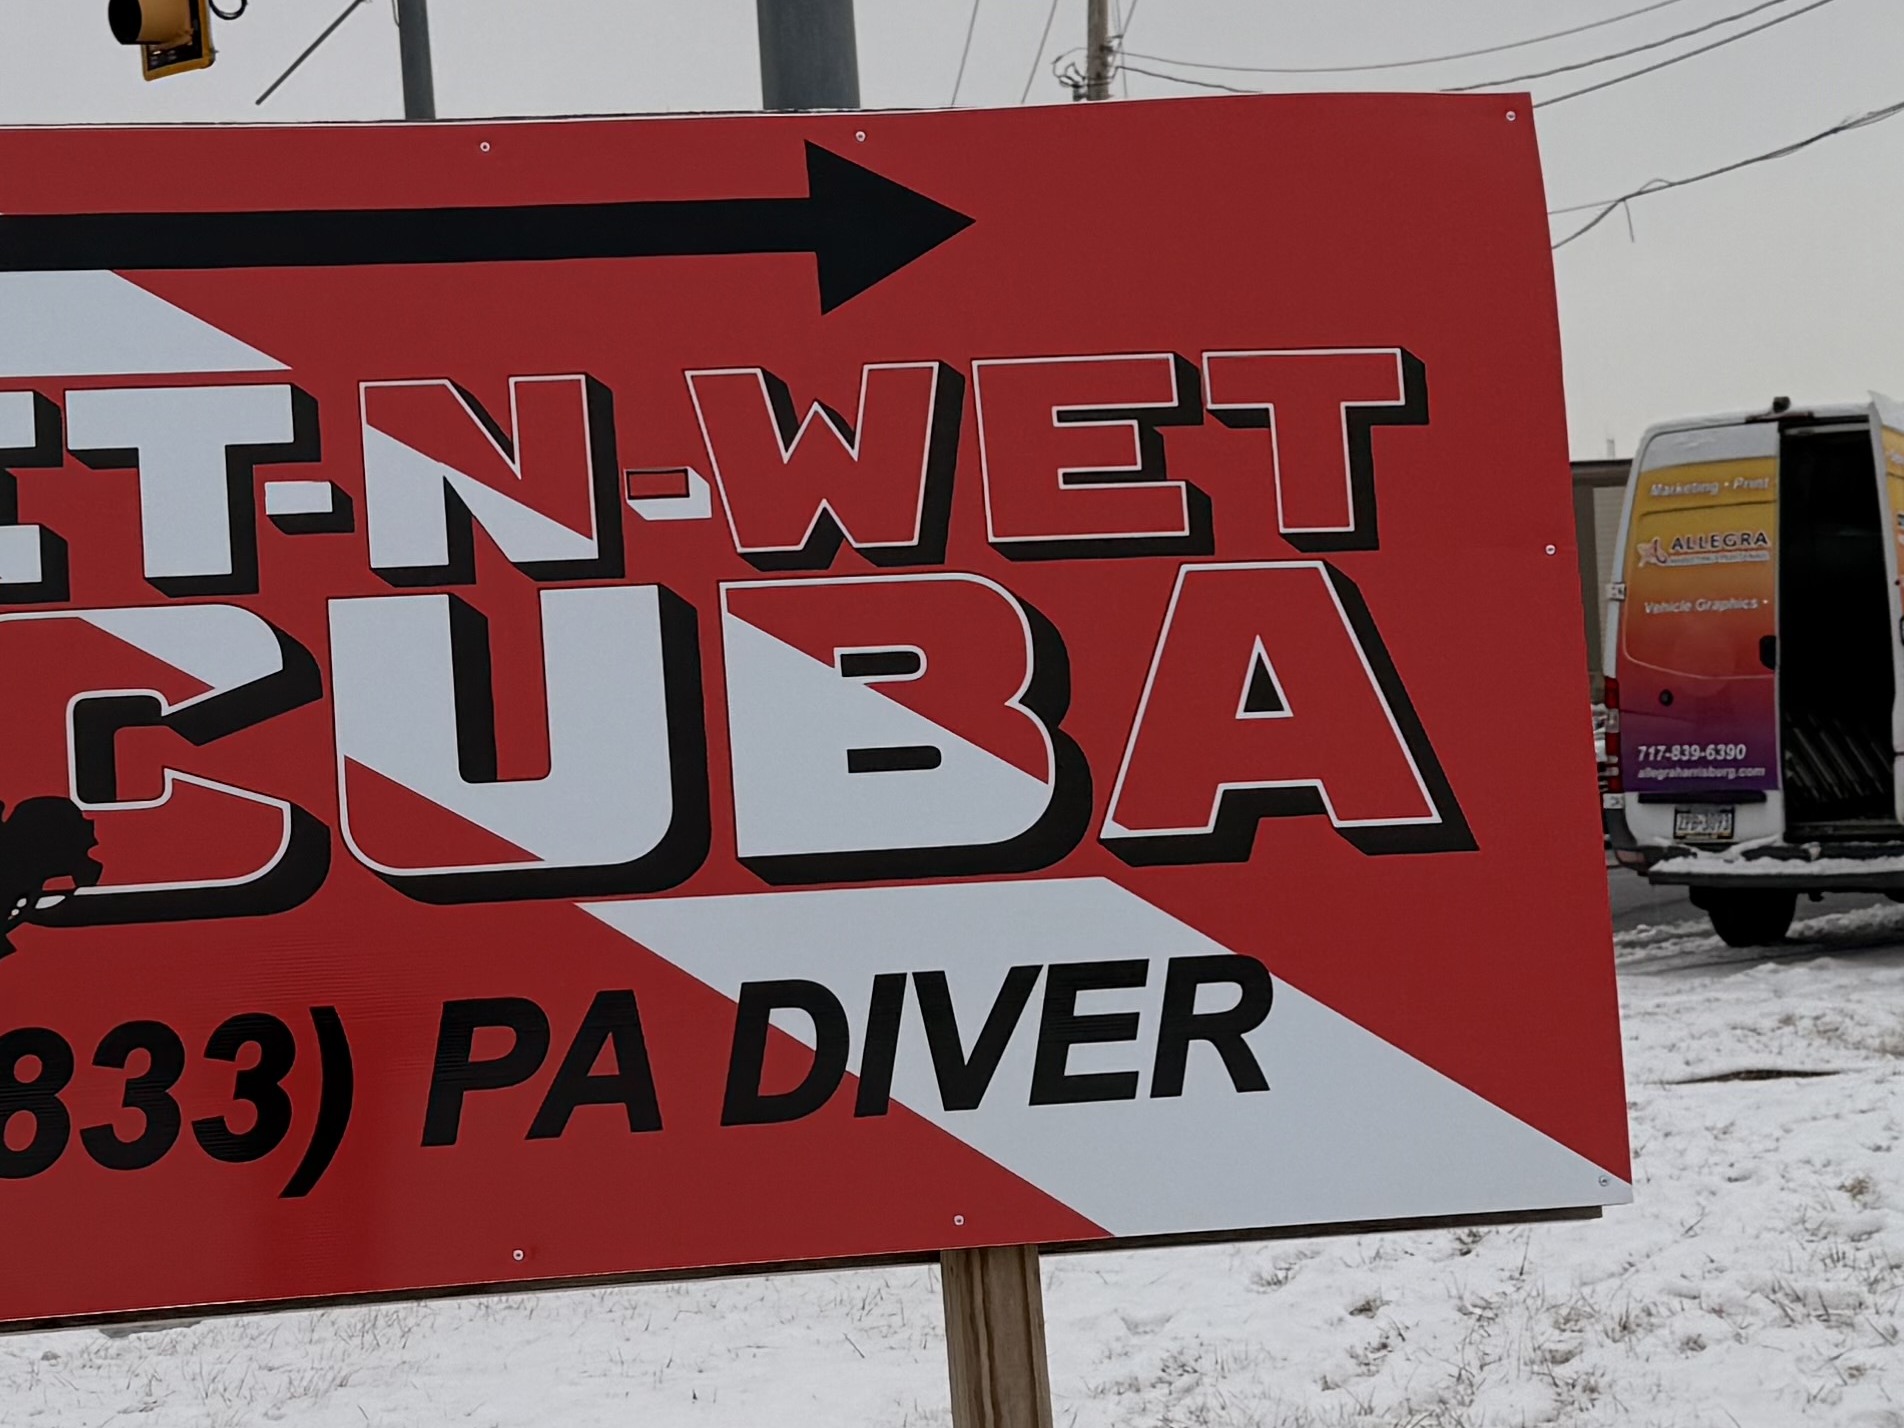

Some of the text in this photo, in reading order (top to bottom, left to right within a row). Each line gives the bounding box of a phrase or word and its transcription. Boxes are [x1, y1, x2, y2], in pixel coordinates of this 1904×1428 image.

[1671, 532, 1768, 551] ALLEGRA
[1637, 743, 1748, 762] 717-839-6390
[420, 988, 664, 1148] PA
[719, 952, 1274, 1128] DIVER
